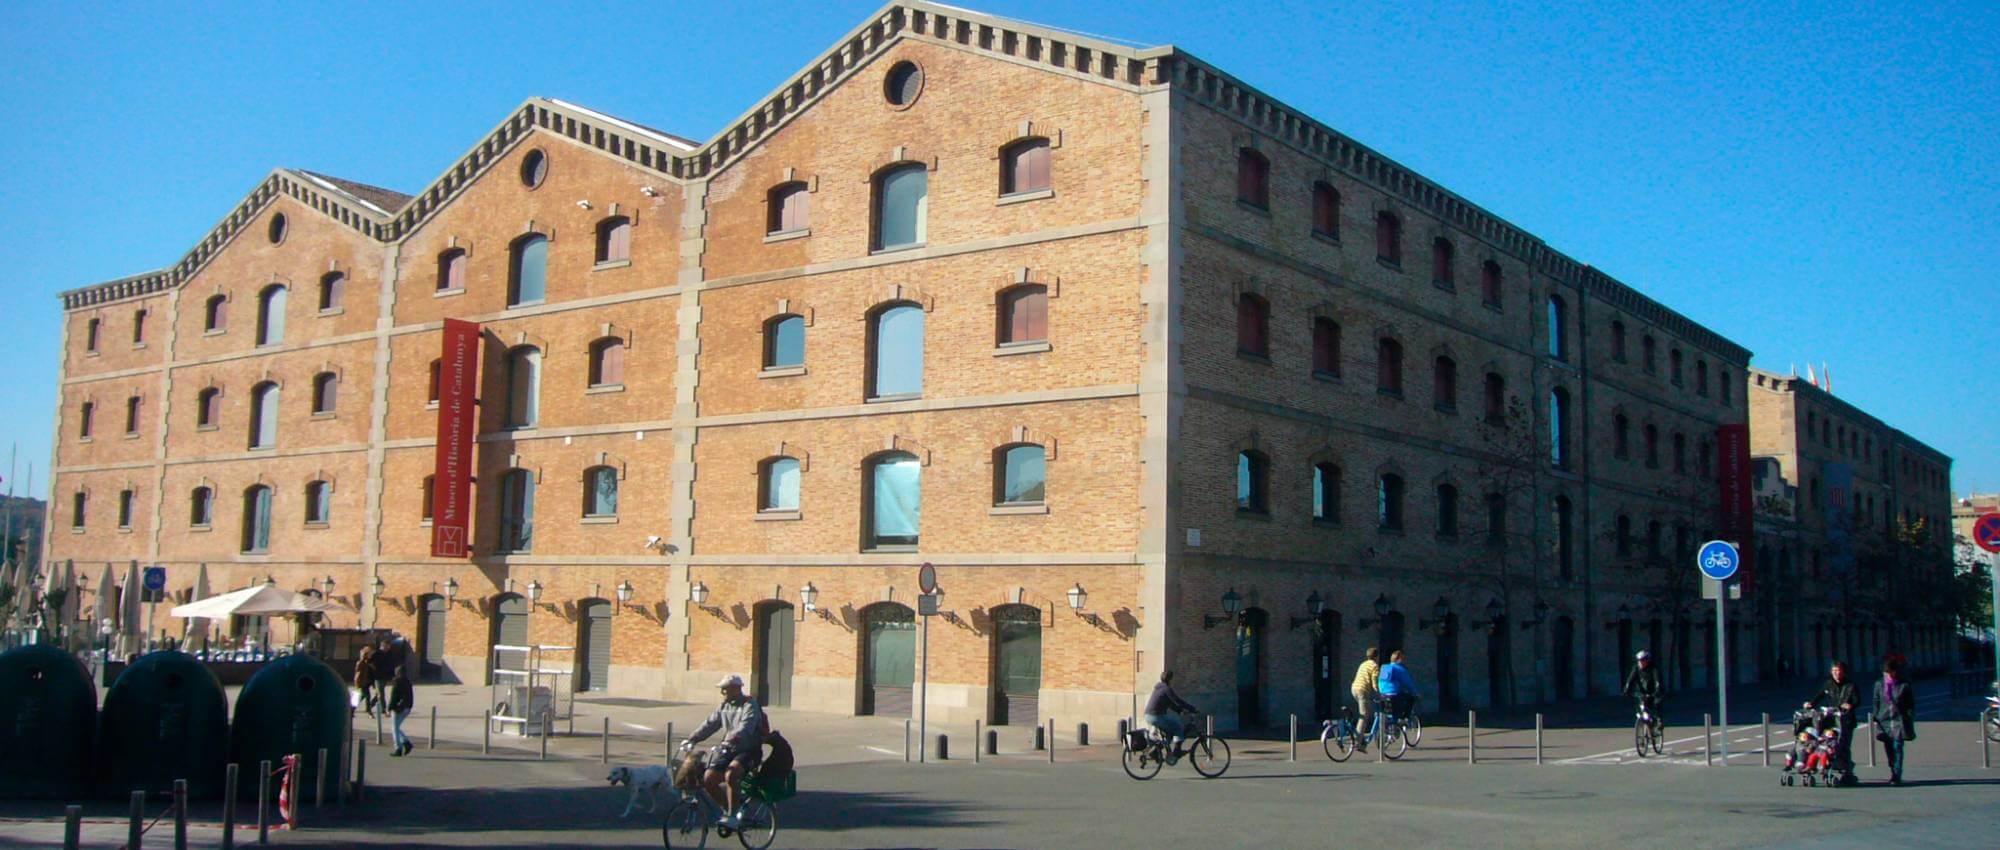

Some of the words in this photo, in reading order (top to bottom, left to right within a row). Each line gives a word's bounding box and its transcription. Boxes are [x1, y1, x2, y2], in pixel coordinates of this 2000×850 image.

[451, 333, 465, 395] Catalunya
[451, 399, 461, 413] de
[447, 417, 461, 477] d'Història
[444, 481, 457, 519] Museu
